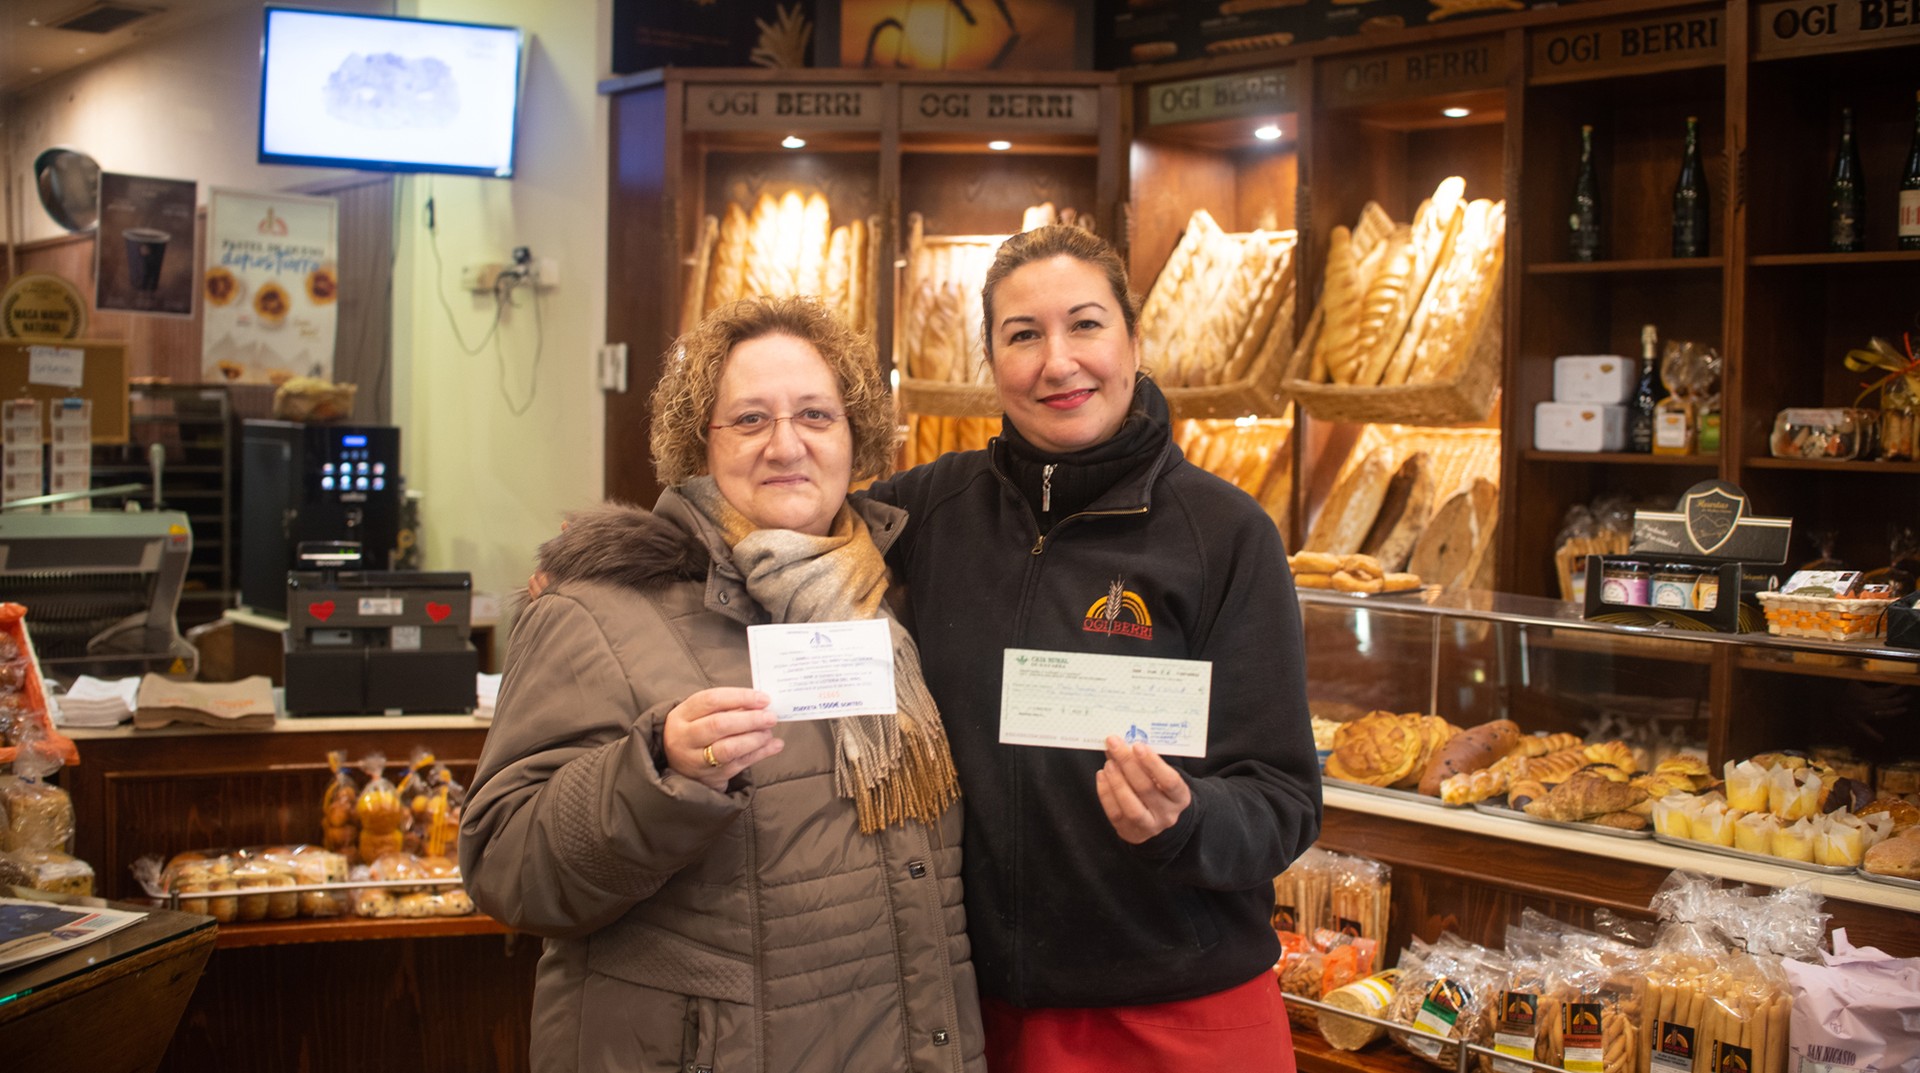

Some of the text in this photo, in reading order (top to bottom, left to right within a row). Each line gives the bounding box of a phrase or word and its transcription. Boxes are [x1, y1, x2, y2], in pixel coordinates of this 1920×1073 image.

[1773, 3, 1837, 39] OGI
[1548, 17, 1718, 65] OGI BERRI
[1344, 47, 1489, 91] OGI BERRI
[708, 92, 861, 117] OGI BERRI
[919, 93, 1073, 118] OGI BERRI
[1160, 75, 1287, 114] OGI BERRI
[1083, 618, 1152, 637] OGI BERRI
[1807, 1043, 1857, 1066] SAN NICASIO
